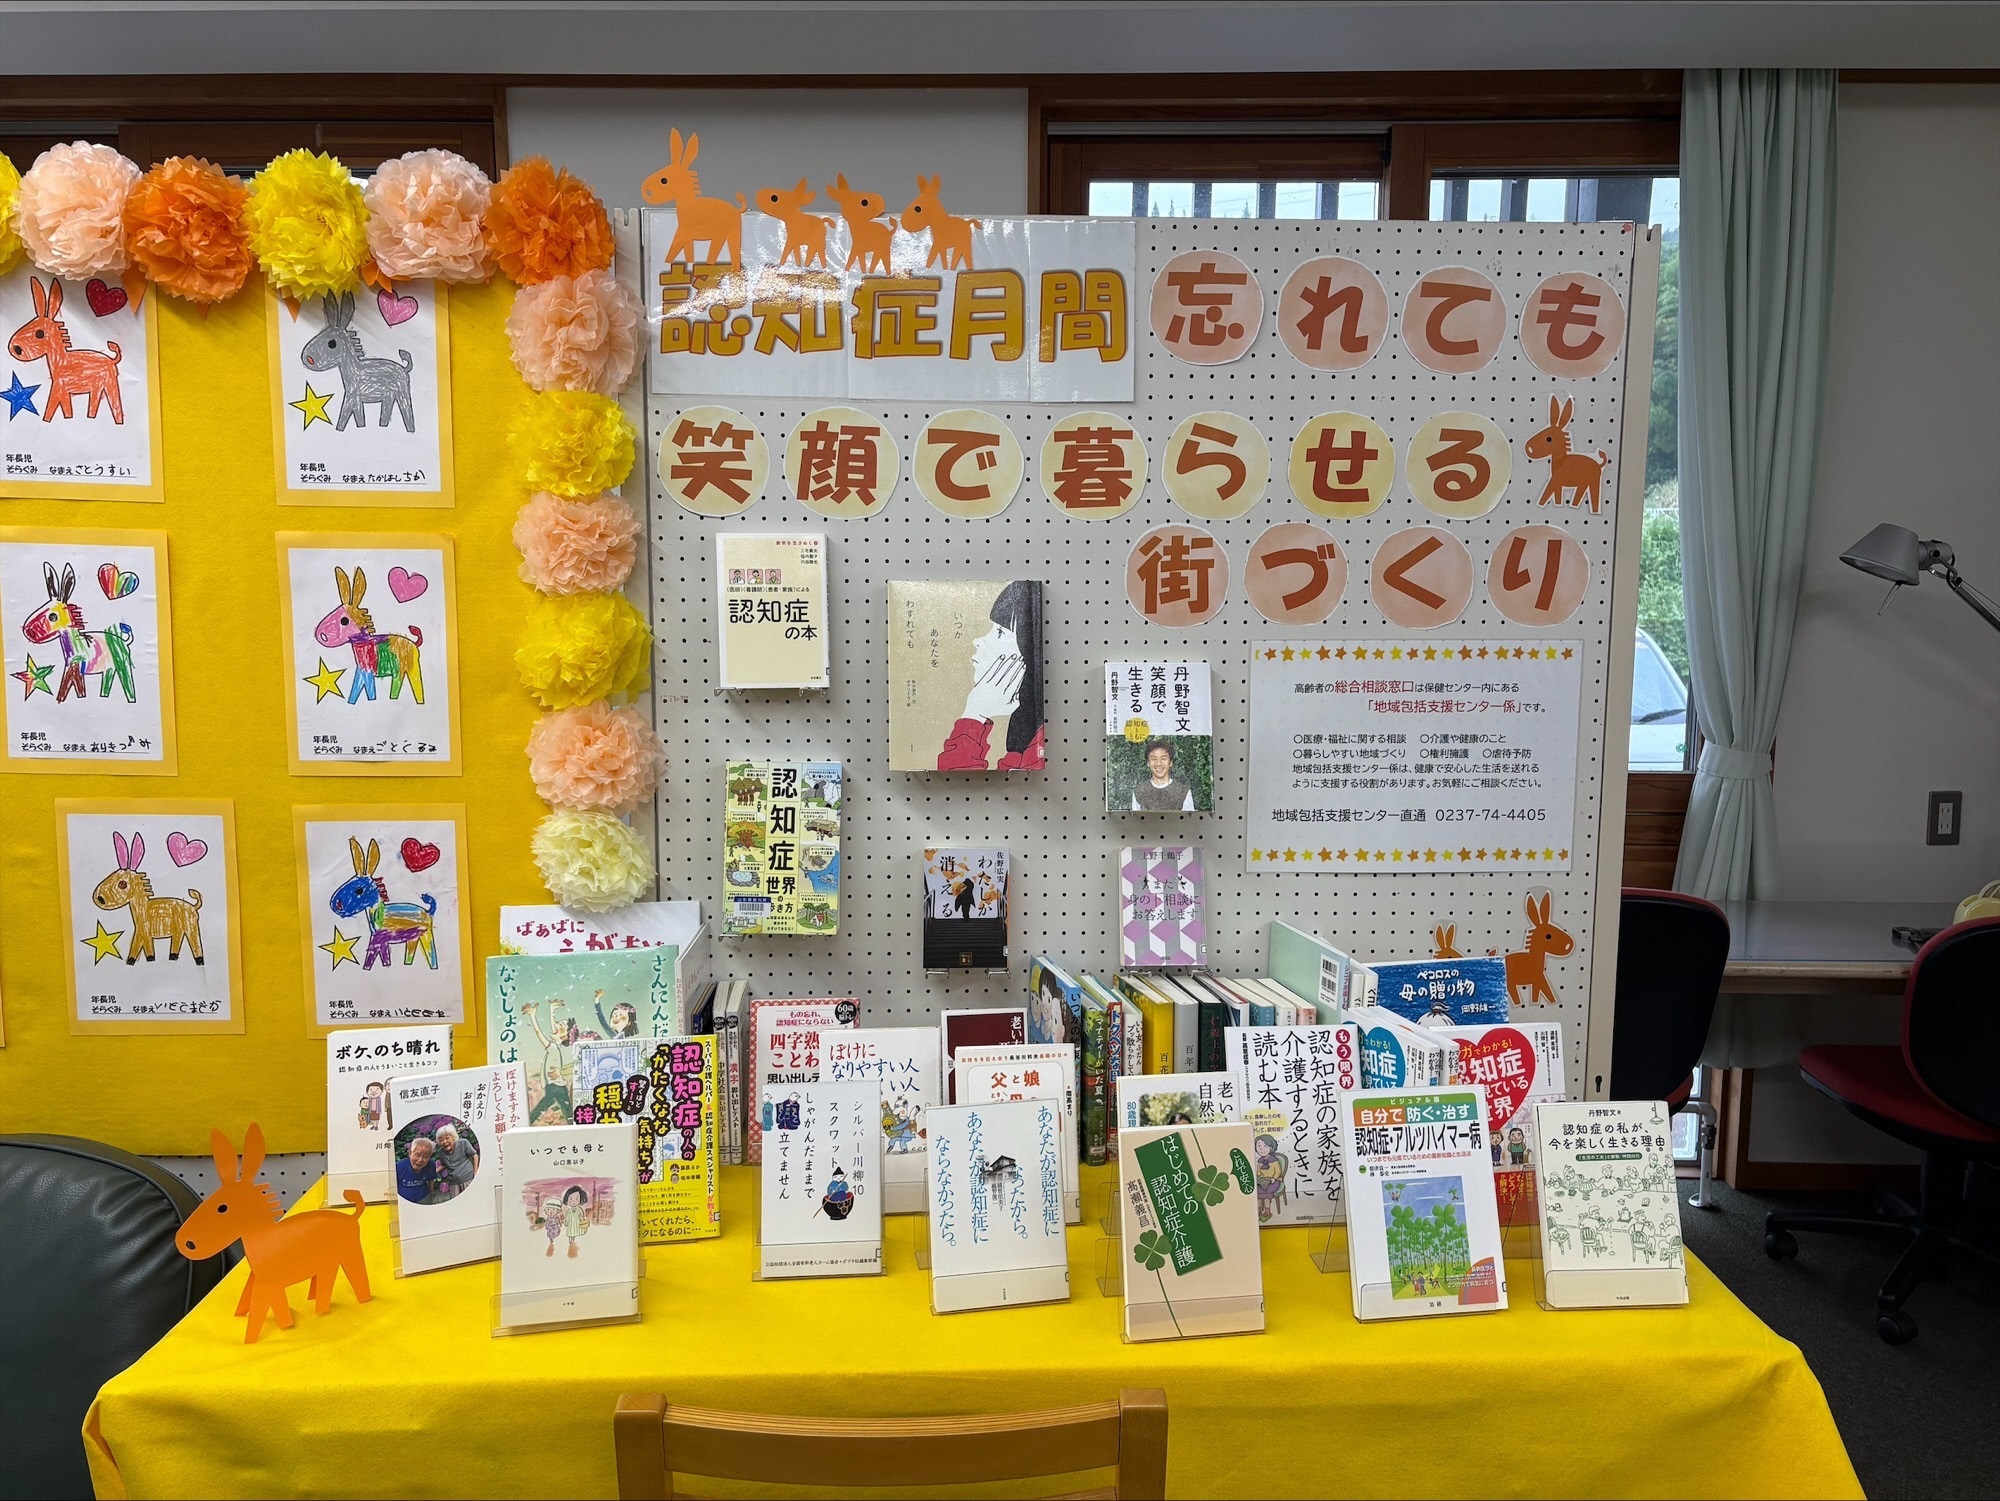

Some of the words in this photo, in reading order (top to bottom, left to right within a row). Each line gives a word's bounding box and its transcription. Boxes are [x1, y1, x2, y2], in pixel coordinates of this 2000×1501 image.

[659, 262, 1127, 363] 認知症月間
[1164, 262, 1605, 361] 忘れても
[5, 453, 33, 463] 年長児
[300, 462, 327, 472] 年長児
[670, 419, 1491, 509] 笑顔で暮らせる
[6, 464, 38, 474] そらぐみ
[49, 466, 73, 475] なまえ
[300, 473, 332, 483] そらぐみ
[342, 474, 366, 483] なまえ
[1137, 534, 1563, 615] 街づくり
[728, 598, 810, 624] 認知症
[784, 624, 818, 641] の本
[905, 599, 915, 650] わすれても
[953, 612, 963, 640] いつか
[930, 628, 939, 668] あなたを
[1111, 671, 1119, 701] 丹野智文
[1128, 666, 1144, 713] 生きる
[1150, 666, 1167, 713] 笑顔で
[1294, 679, 1520, 694] 高齢者の総合相談窓口は保健センター内にある
[1173, 666, 1191, 732] 丹野智文
[1366, 699, 1547, 714] 「地域包括支援センター係」です。
[20, 732, 47, 741] 年長児
[21, 742, 52, 751] そらぐみ
[62, 743, 87, 752] なまえ
[312, 735, 338, 744] 年長児
[313, 745, 343, 754] そらぐみ
[353, 745, 376, 754] なまえ
[1293, 763, 1540, 775] 地域包括支援センター係は、健康で安心した生活を送れる
[1292, 778, 1543, 789] ように支援する役割があります。お気軽にご相談ください。
[769, 767, 798, 871] 認知症
[1271, 808, 1427, 823] 地域包括支援センター直通
[1435, 808, 1546, 822] 0237-74-4405
[1141, 851, 1184, 861] 上野千鶴子
[996, 851, 1004, 883] 佐野広実
[766, 876, 797, 895] 世界
[939, 855, 956, 918] 消える
[1127, 892, 1201, 907] 身の下相談に
[1132, 908, 1199, 921] お答えします
[516, 918, 585, 938] ばぁばに
[1417, 968, 1460, 981] ペコロスの
[91, 995, 117, 1004] 年長児
[1399, 979, 1476, 1002] 母の贈り物
[91, 1005, 122, 1014] そらぐみ
[132, 1005, 155, 1014] なまえ
[328, 1000, 354, 1009] 年長児
[329, 1010, 359, 1018] そらぐみ
[369, 1009, 391, 1018] なまえ
[789, 1010, 822, 1018] もの忘れ、
[775, 1018, 835, 1027] 認知症にならない
[336, 1039, 441, 1060] ボケ、のち晴れ
[770, 1031, 820, 1051] 四字熟
[829, 1042, 877, 1061] ぼけに
[338, 1060, 439, 1073] 認知症の人とうまいこと生きるコツ
[771, 1051, 820, 1069] ことわ
[1094, 1017, 1104, 1096] マナティーがいた夏
[1336, 1030, 1354, 1090] もう限界
[1360, 1049, 1398, 1080] 知症
[729, 1062, 739, 1084] 漢字
[831, 1058, 920, 1080] なりやすい人
[990, 1069, 1041, 1089] 父と娘
[1252, 1031, 1282, 1110] 読む本
[399, 1084, 441, 1100] 信友直子
[476, 1083, 488, 1120] おかえり
[672, 1044, 702, 1159] 認知症の人の
[1390, 1096, 1440, 1105] ビジュアル版
[462, 1091, 474, 1129] お母さん
[731, 1086, 740, 1128] 思い出しテスト
[1281, 1030, 1315, 1199] 介護するときに
[1307, 1030, 1344, 1201] 認知症の家族を
[1360, 1108, 1403, 1124] 自分で
[1406, 1103, 1470, 1121] 防ぐ・治す
[829, 1102, 839, 1169] スクワット
[1354, 1120, 1482, 1157] 認知症・アルツハイマー病
[1562, 1122, 1650, 1136] 認知症の私が、
[530, 1143, 605, 1156] いつでも母と
[803, 1092, 816, 1199] しゃがんだままで
[852, 1101, 865, 1196] シルバー川柳10
[1548, 1135, 1666, 1151] 今を楽しく生きる理由
[553, 1158, 585, 1167] 山口恵以子
[778, 1132, 791, 1200] 立てません
[1038, 1105, 1060, 1237] あなたが認知症に
[967, 1111, 989, 1244] あなたが認知症に
[1161, 1136, 1199, 1215] はじめての
[936, 1135, 957, 1247] ならなかったら。
[1010, 1163, 1029, 1240] なったから。
[1150, 1174, 1197, 1269] 認知症介護
